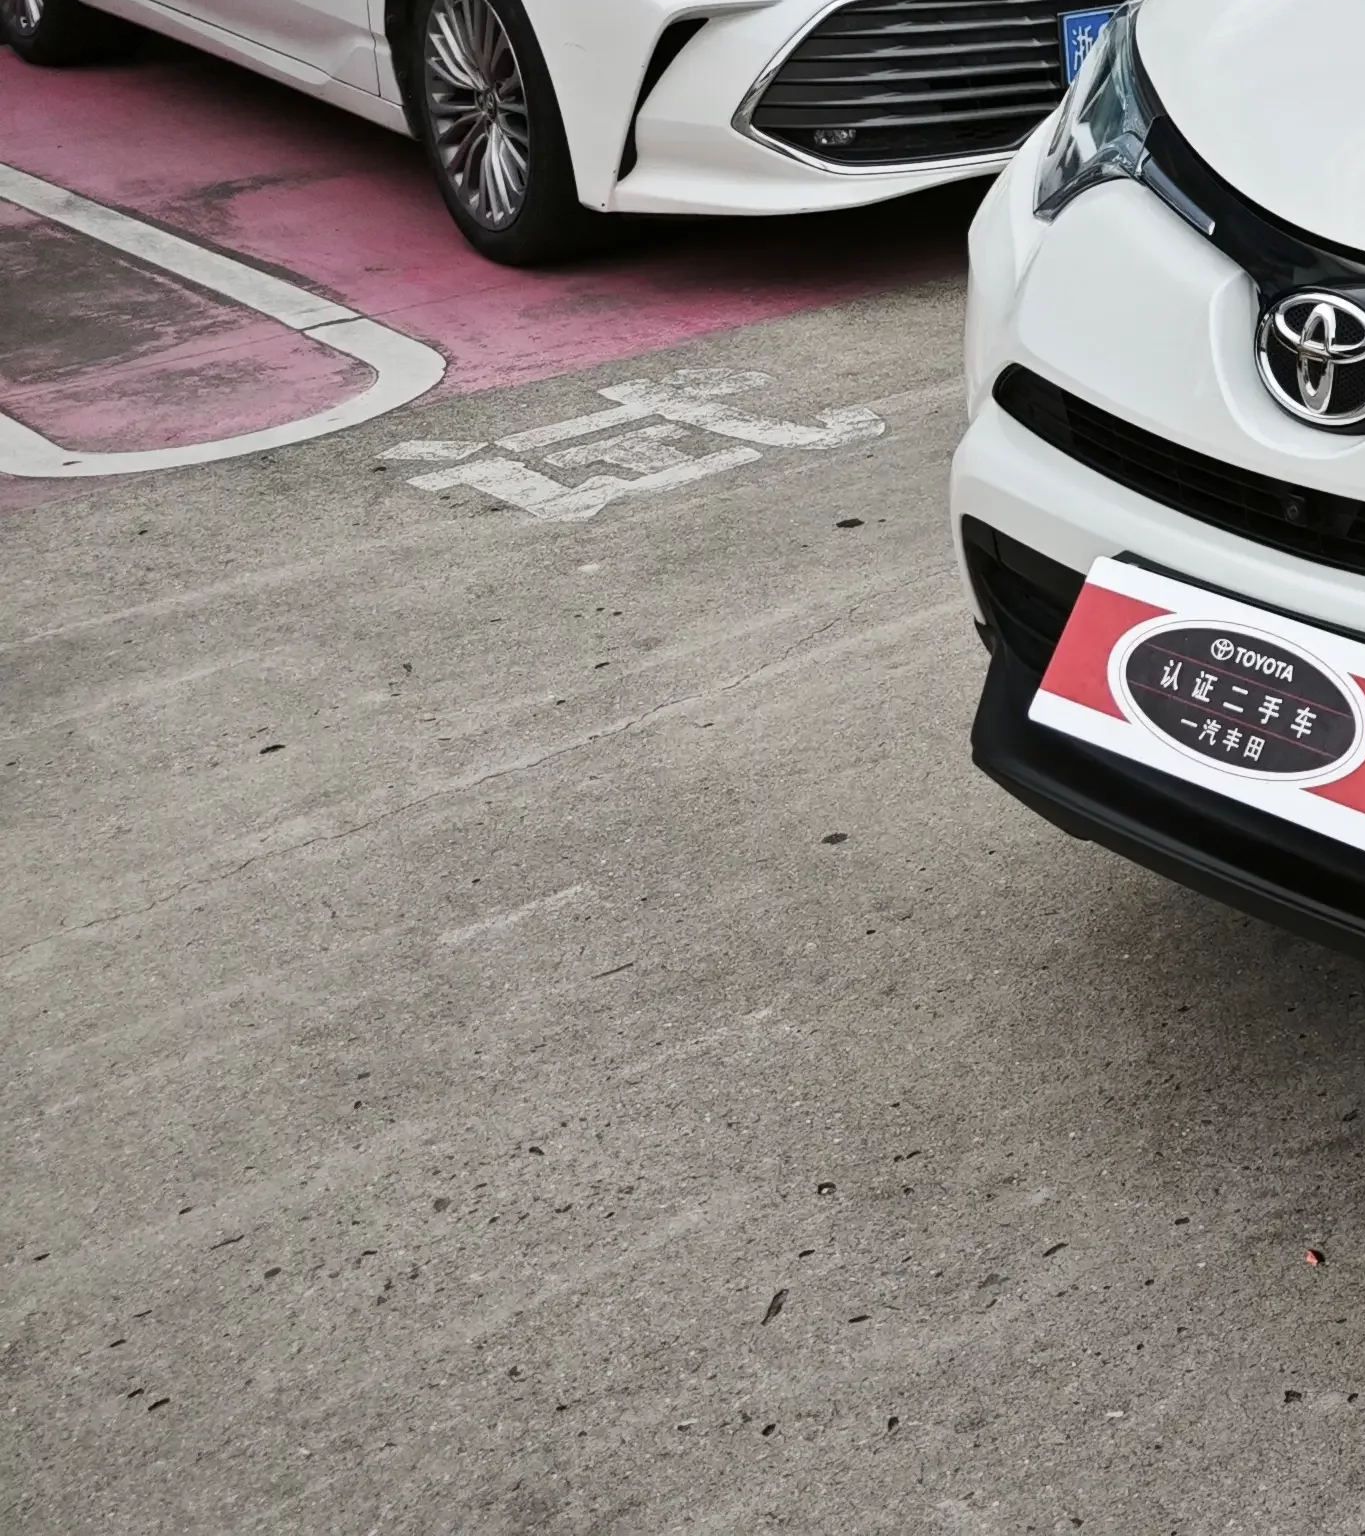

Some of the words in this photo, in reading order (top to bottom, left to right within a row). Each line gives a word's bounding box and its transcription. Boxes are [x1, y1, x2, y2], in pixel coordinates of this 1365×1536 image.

[1235, 647, 1294, 683] TOYOTA
[1159, 658, 1318, 740] 认证二手车
[1179, 717, 1266, 762] 一汽丰田
